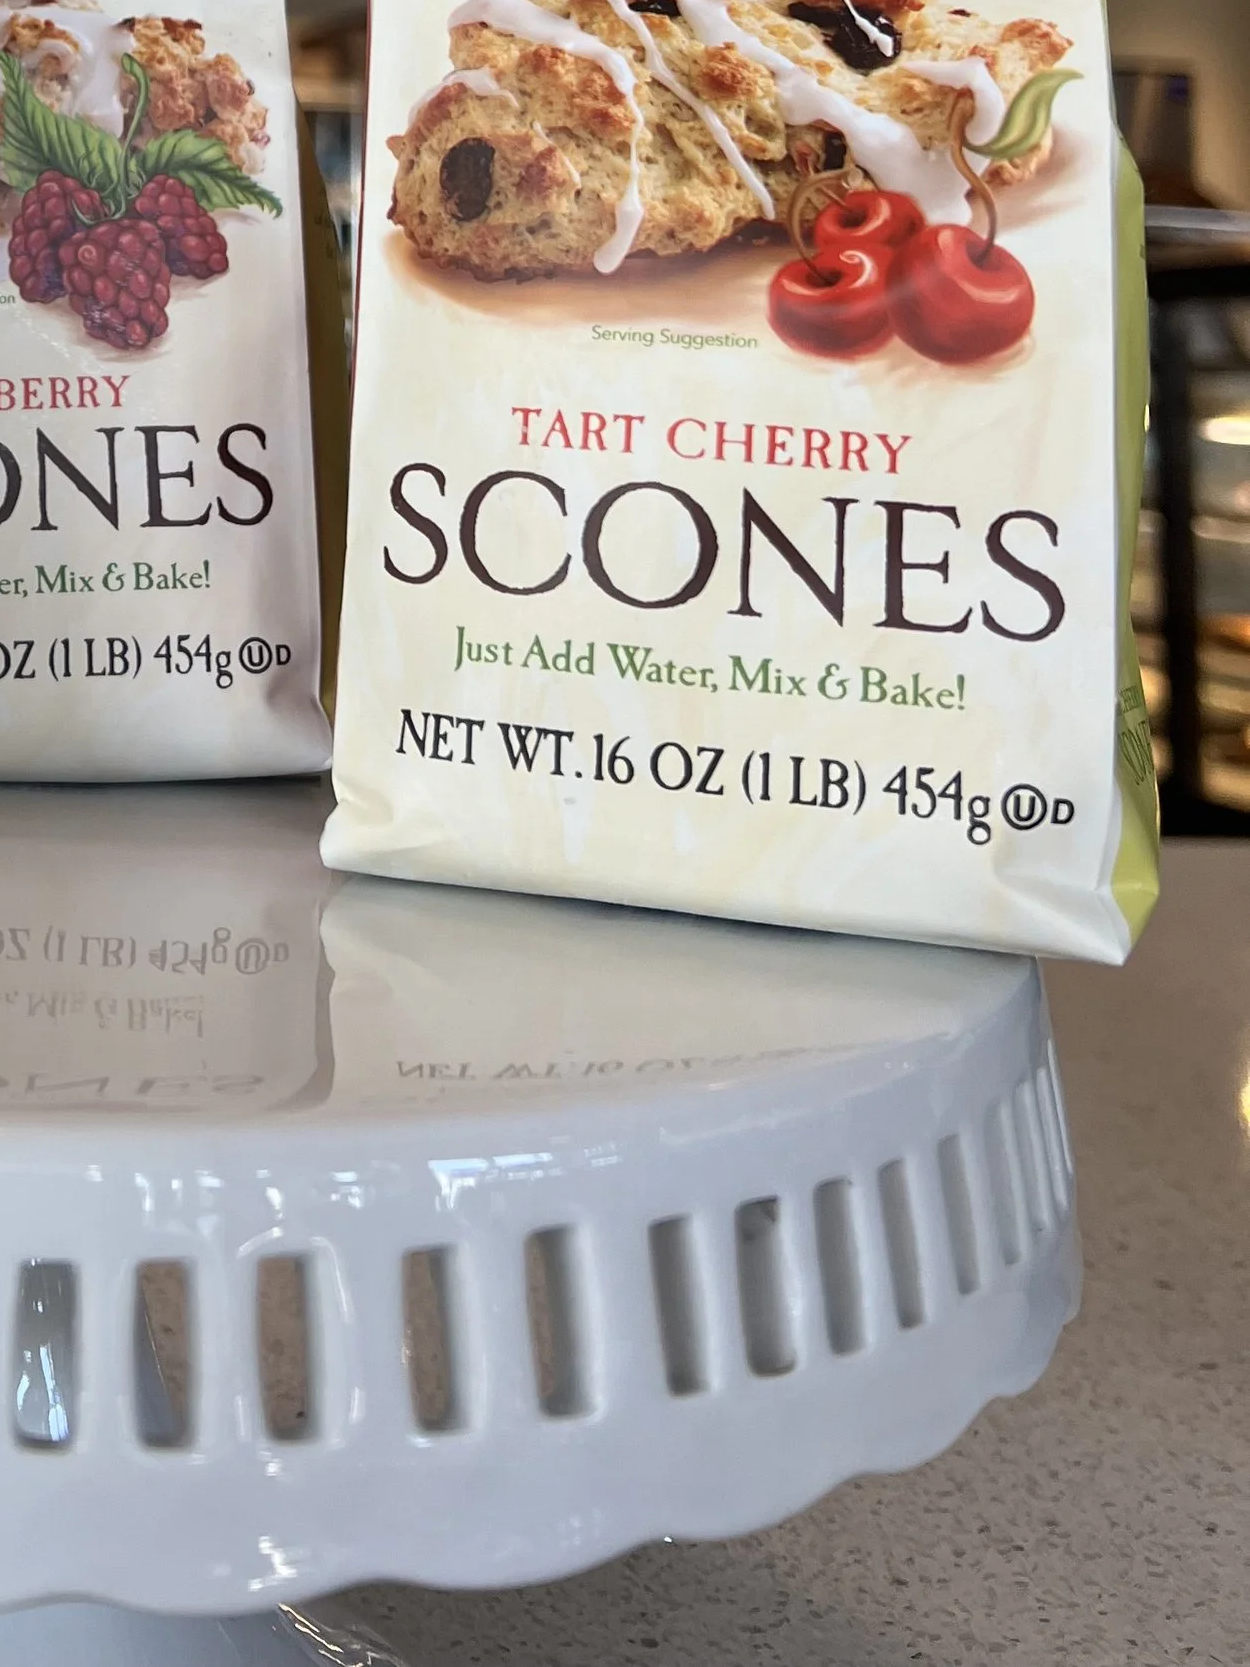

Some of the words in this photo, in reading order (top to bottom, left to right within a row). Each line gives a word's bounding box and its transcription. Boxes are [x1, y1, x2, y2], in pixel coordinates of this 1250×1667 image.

[590, 324, 655, 348] Serving
[659, 329, 759, 352] Suggestion
[511, 406, 646, 455] TART
[665, 416, 913, 475] CHERRY
[34, 563, 94, 595] Mix
[102, 562, 125, 591] &
[133, 560, 211, 591] Bake!
[382, 462, 1066, 642] SCONES
[48, 640, 73, 680] (1
[84, 637, 143, 679] LB)
[153, 634, 232, 689] 454g
[455, 625, 513, 672] Just
[520, 634, 595, 676] Add
[606, 642, 719, 693] Water,
[728, 654, 806, 697] Mix
[816, 663, 849, 700] &
[859, 665, 967, 711] Bake!
[396, 709, 485, 766] NET
[649, 742, 725, 798] OZ
[741, 749, 774, 803] (1
[789, 755, 868, 814] LB)
[881, 764, 991, 845] 454g
